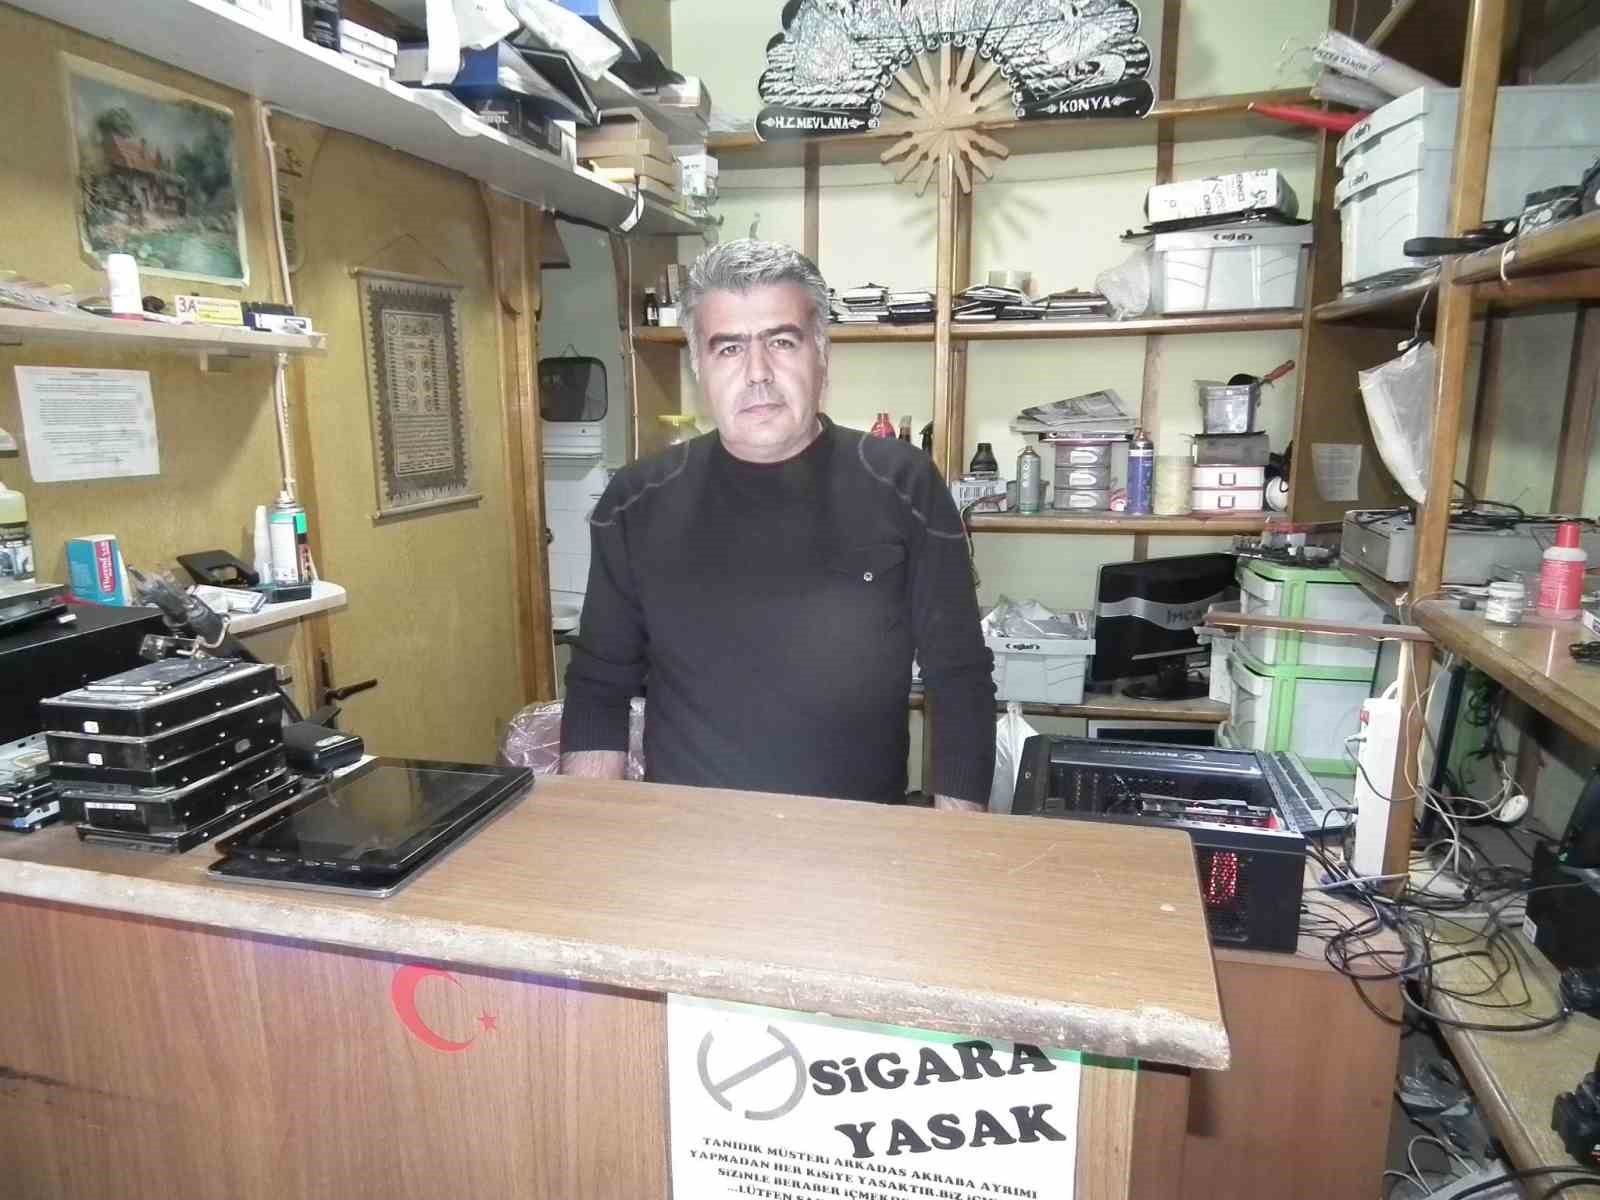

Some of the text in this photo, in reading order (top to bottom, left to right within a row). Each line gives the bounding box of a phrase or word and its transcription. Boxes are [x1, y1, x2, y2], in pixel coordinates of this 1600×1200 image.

[1059, 95, 1111, 114] KONYA
[834, 1103, 1067, 1158] YASAK
[690, 1149, 770, 1169] YAPMADAN
[774, 1162, 802, 1175] HER
[702, 1136, 763, 1154] TANIDIK
[911, 1170, 976, 1189] AKRABA
[980, 1183, 1038, 1200] AYRIMI
[774, 1176, 840, 1196] BERABER
